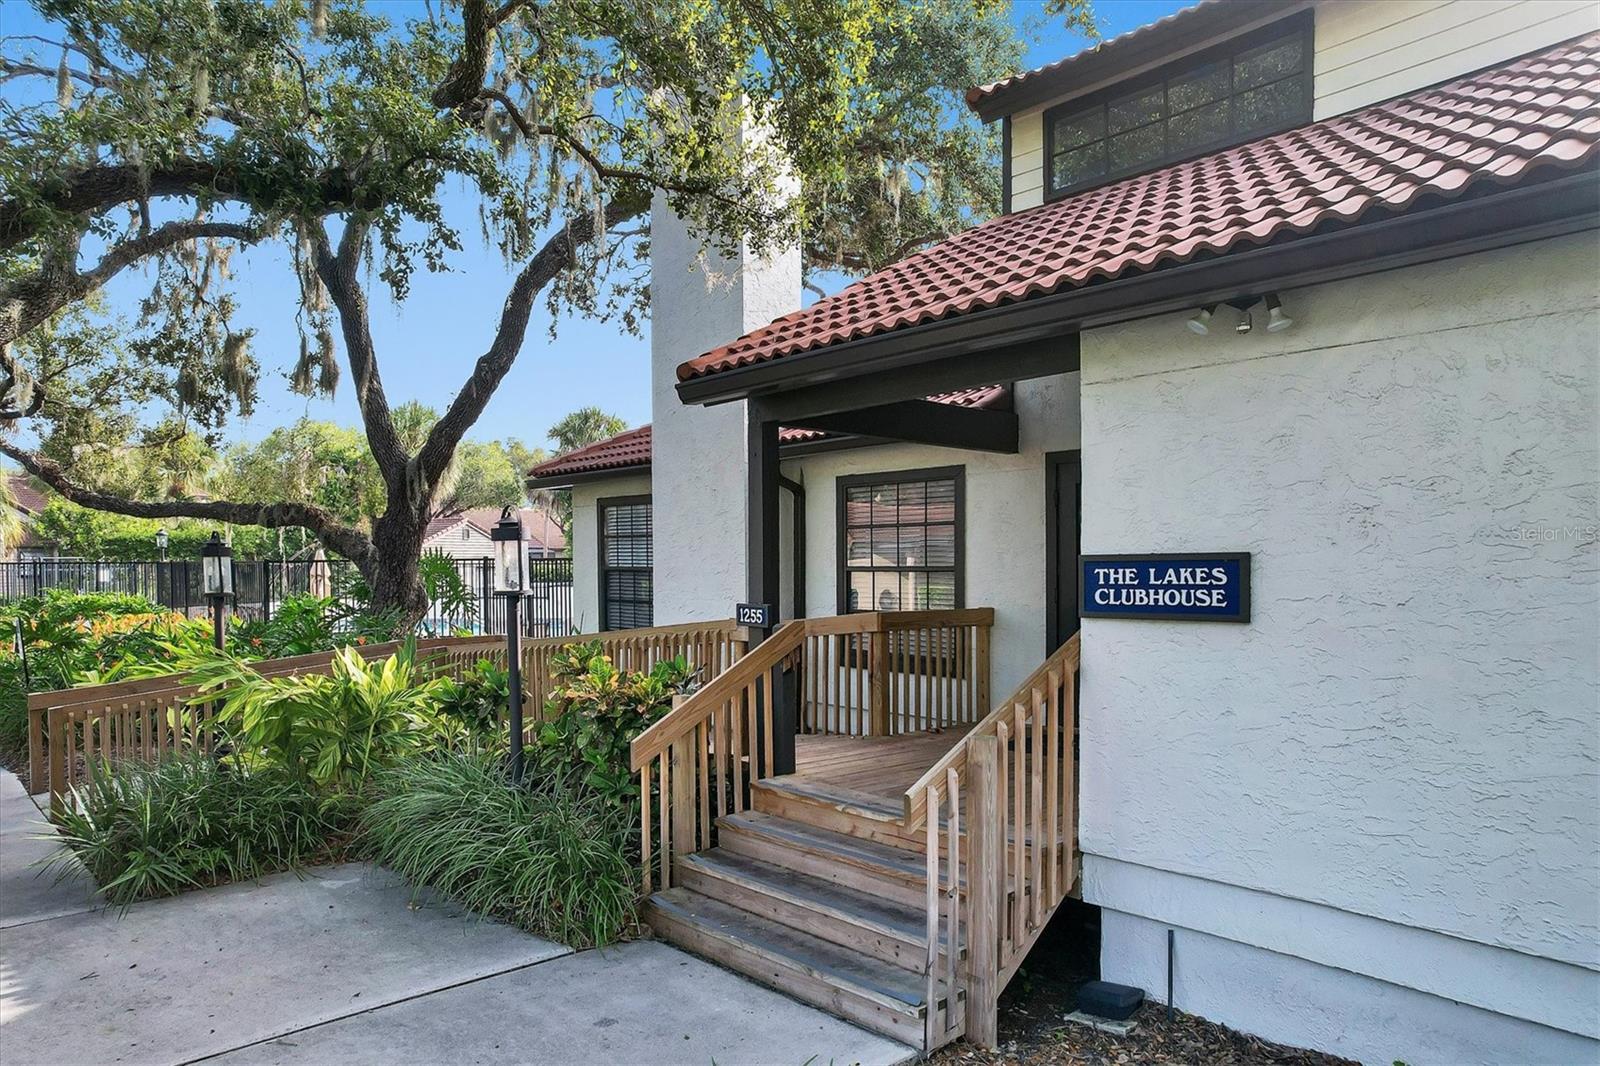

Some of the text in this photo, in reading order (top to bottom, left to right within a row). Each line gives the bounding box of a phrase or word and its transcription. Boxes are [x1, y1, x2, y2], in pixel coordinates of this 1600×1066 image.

[1094, 567, 1228, 585] THE LAKES
[1094, 588, 1228, 607] CLUBHOUSE
[740, 608, 763, 623] 1255
